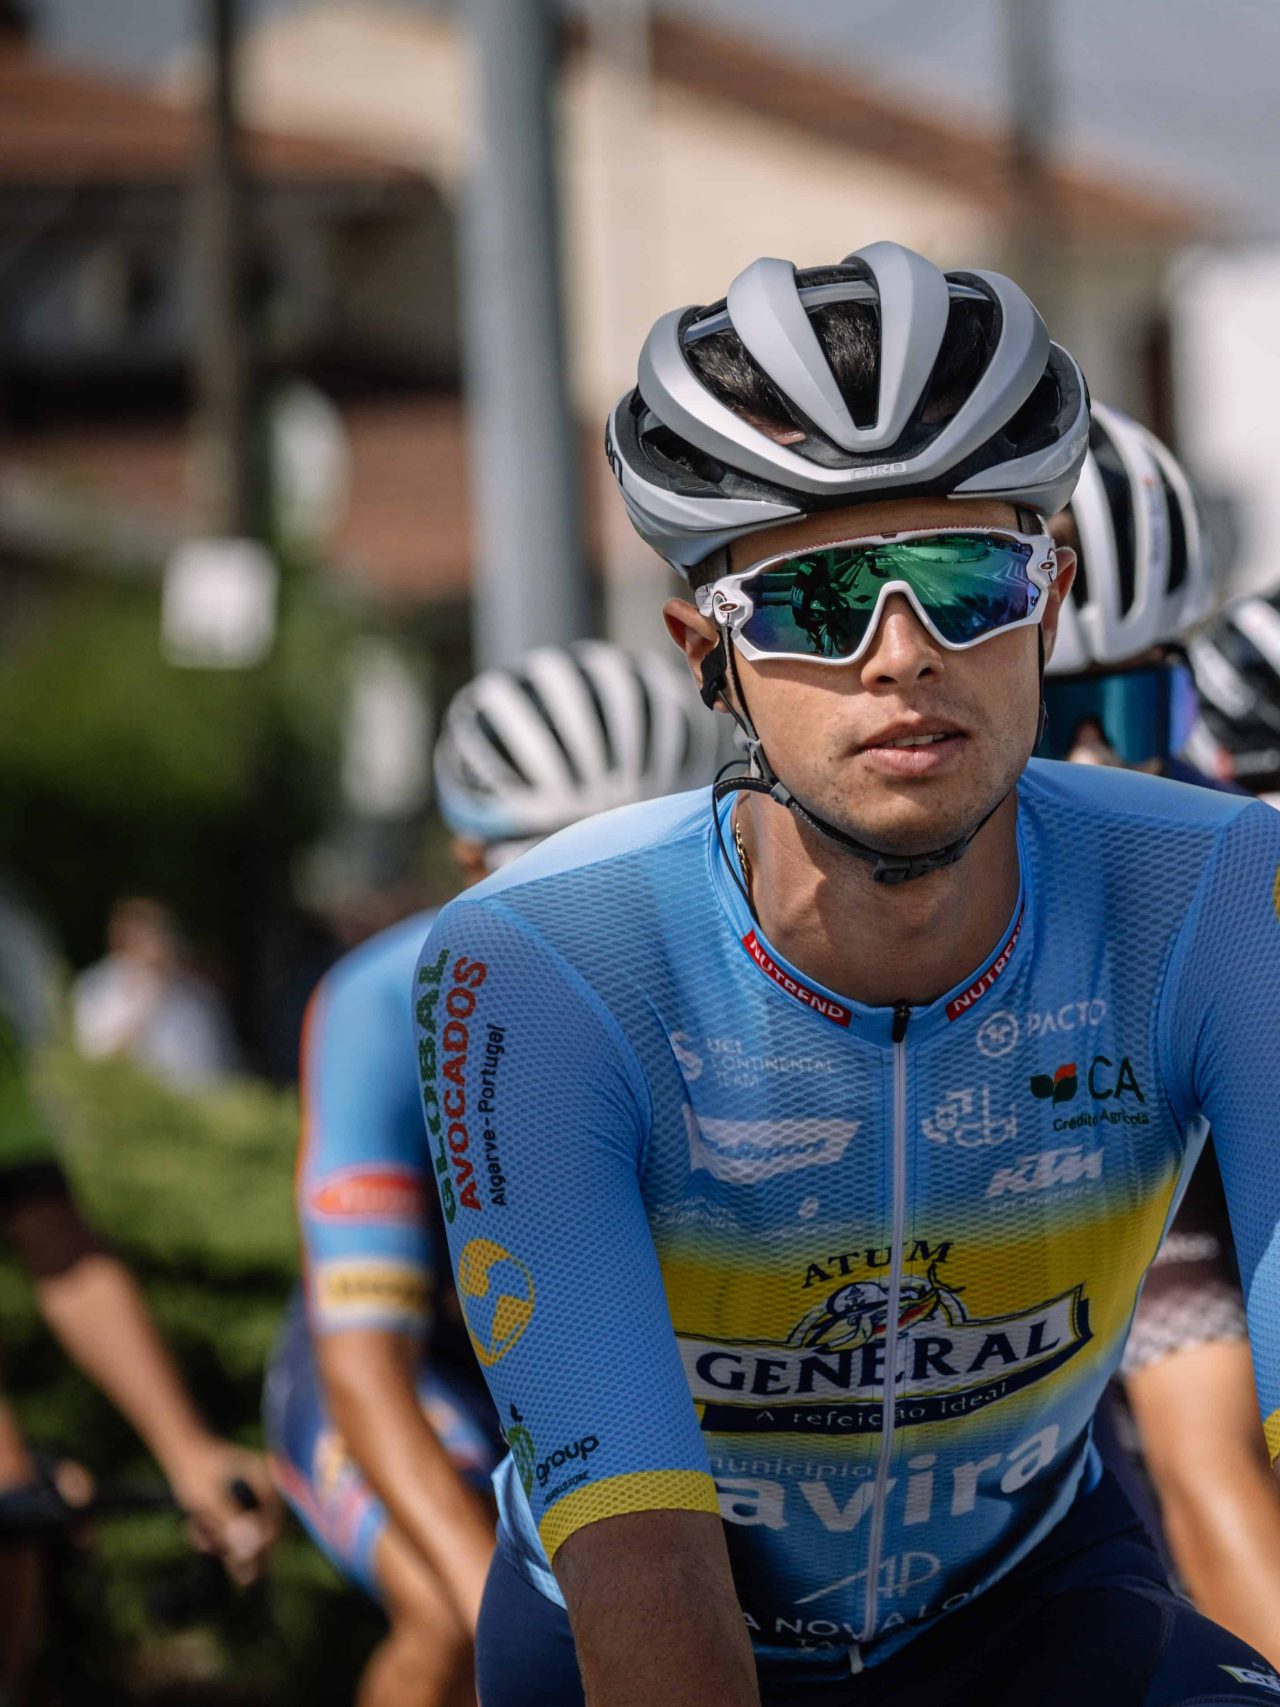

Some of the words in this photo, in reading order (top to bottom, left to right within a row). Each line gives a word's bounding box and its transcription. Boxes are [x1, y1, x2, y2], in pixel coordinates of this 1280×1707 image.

[749, 938, 844, 1018] NUTREND
[953, 913, 1023, 1012] NUTRE
[1026, 998, 1107, 1038] PACTO
[416, 949, 457, 1224] GLOBAL
[442, 956, 488, 1211] AVOCADOS
[711, 1055, 833, 1074] ONTINENTAL
[1088, 1055, 1145, 1103] CA
[986, 1144, 1104, 1198] KTM
[802, 1240, 955, 1289] ATUM
[695, 1320, 1061, 1396] GENERAL
[755, 1410, 775, 1422] A
[536, 1435, 599, 1488] group
[775, 1611, 906, 1642] NOVA
